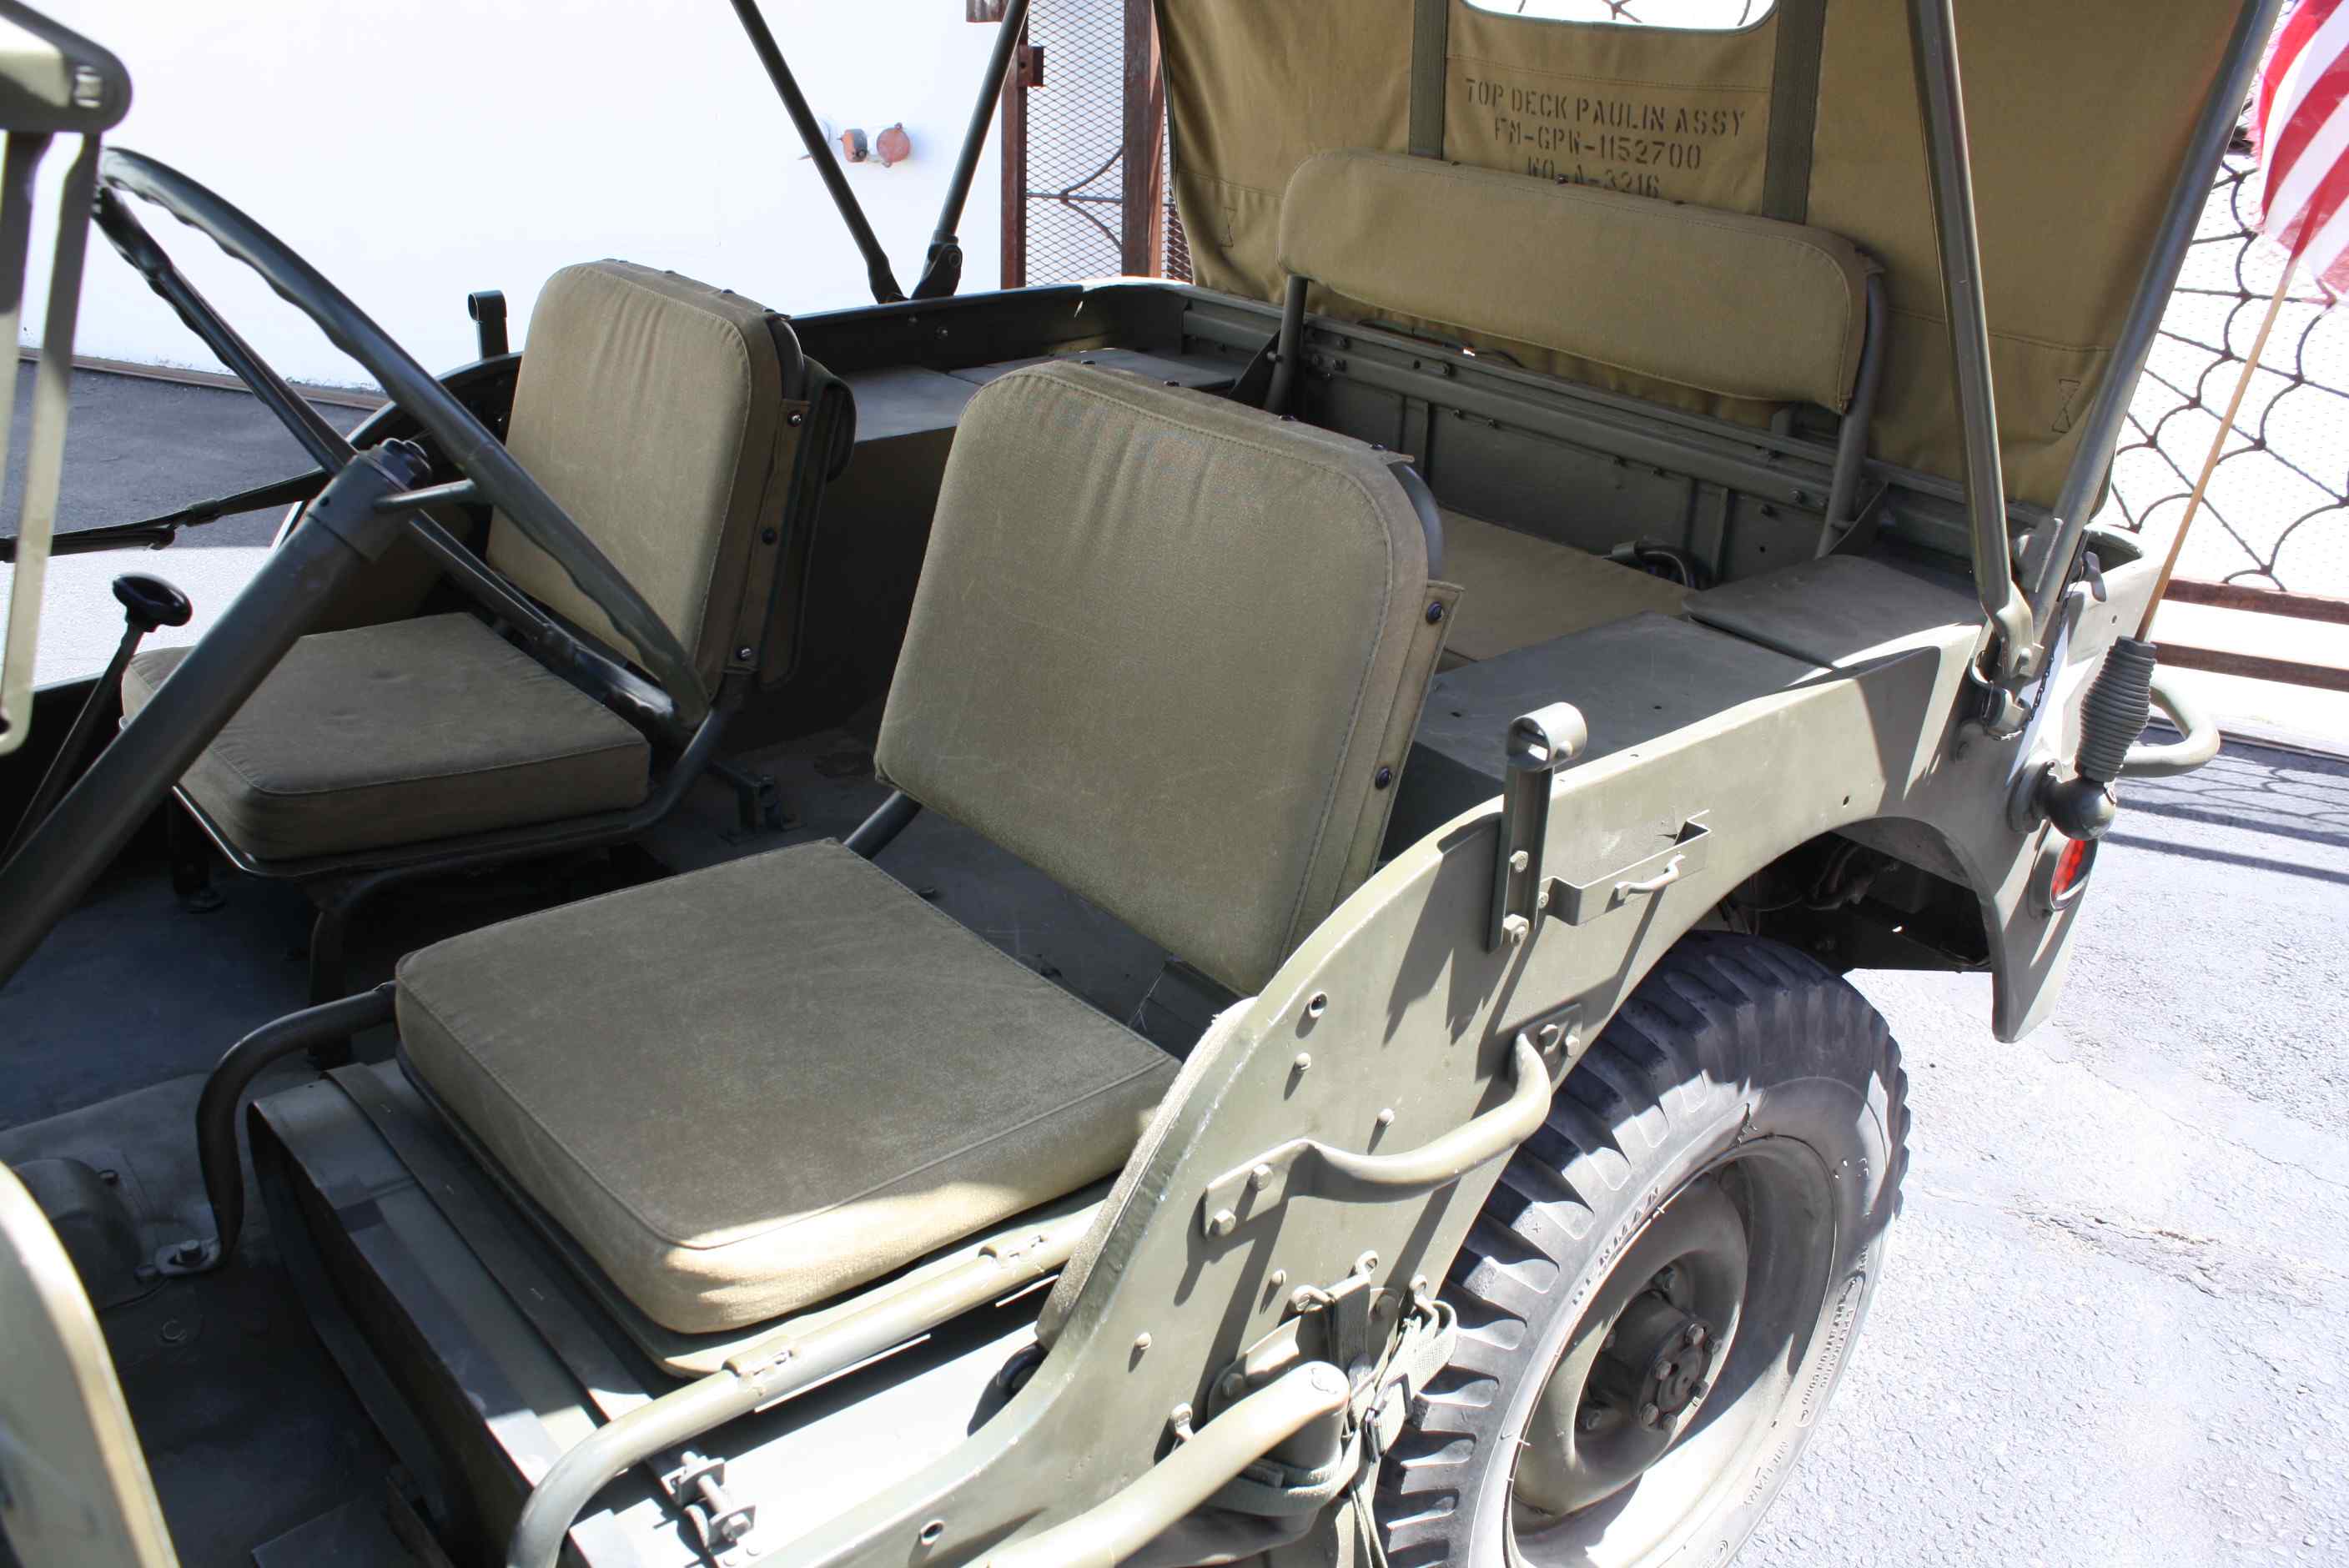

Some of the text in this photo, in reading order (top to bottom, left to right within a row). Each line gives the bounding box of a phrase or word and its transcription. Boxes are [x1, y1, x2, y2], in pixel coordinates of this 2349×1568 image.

[1466, 78, 1746, 137] TOP DECK PAULIN ASSY
